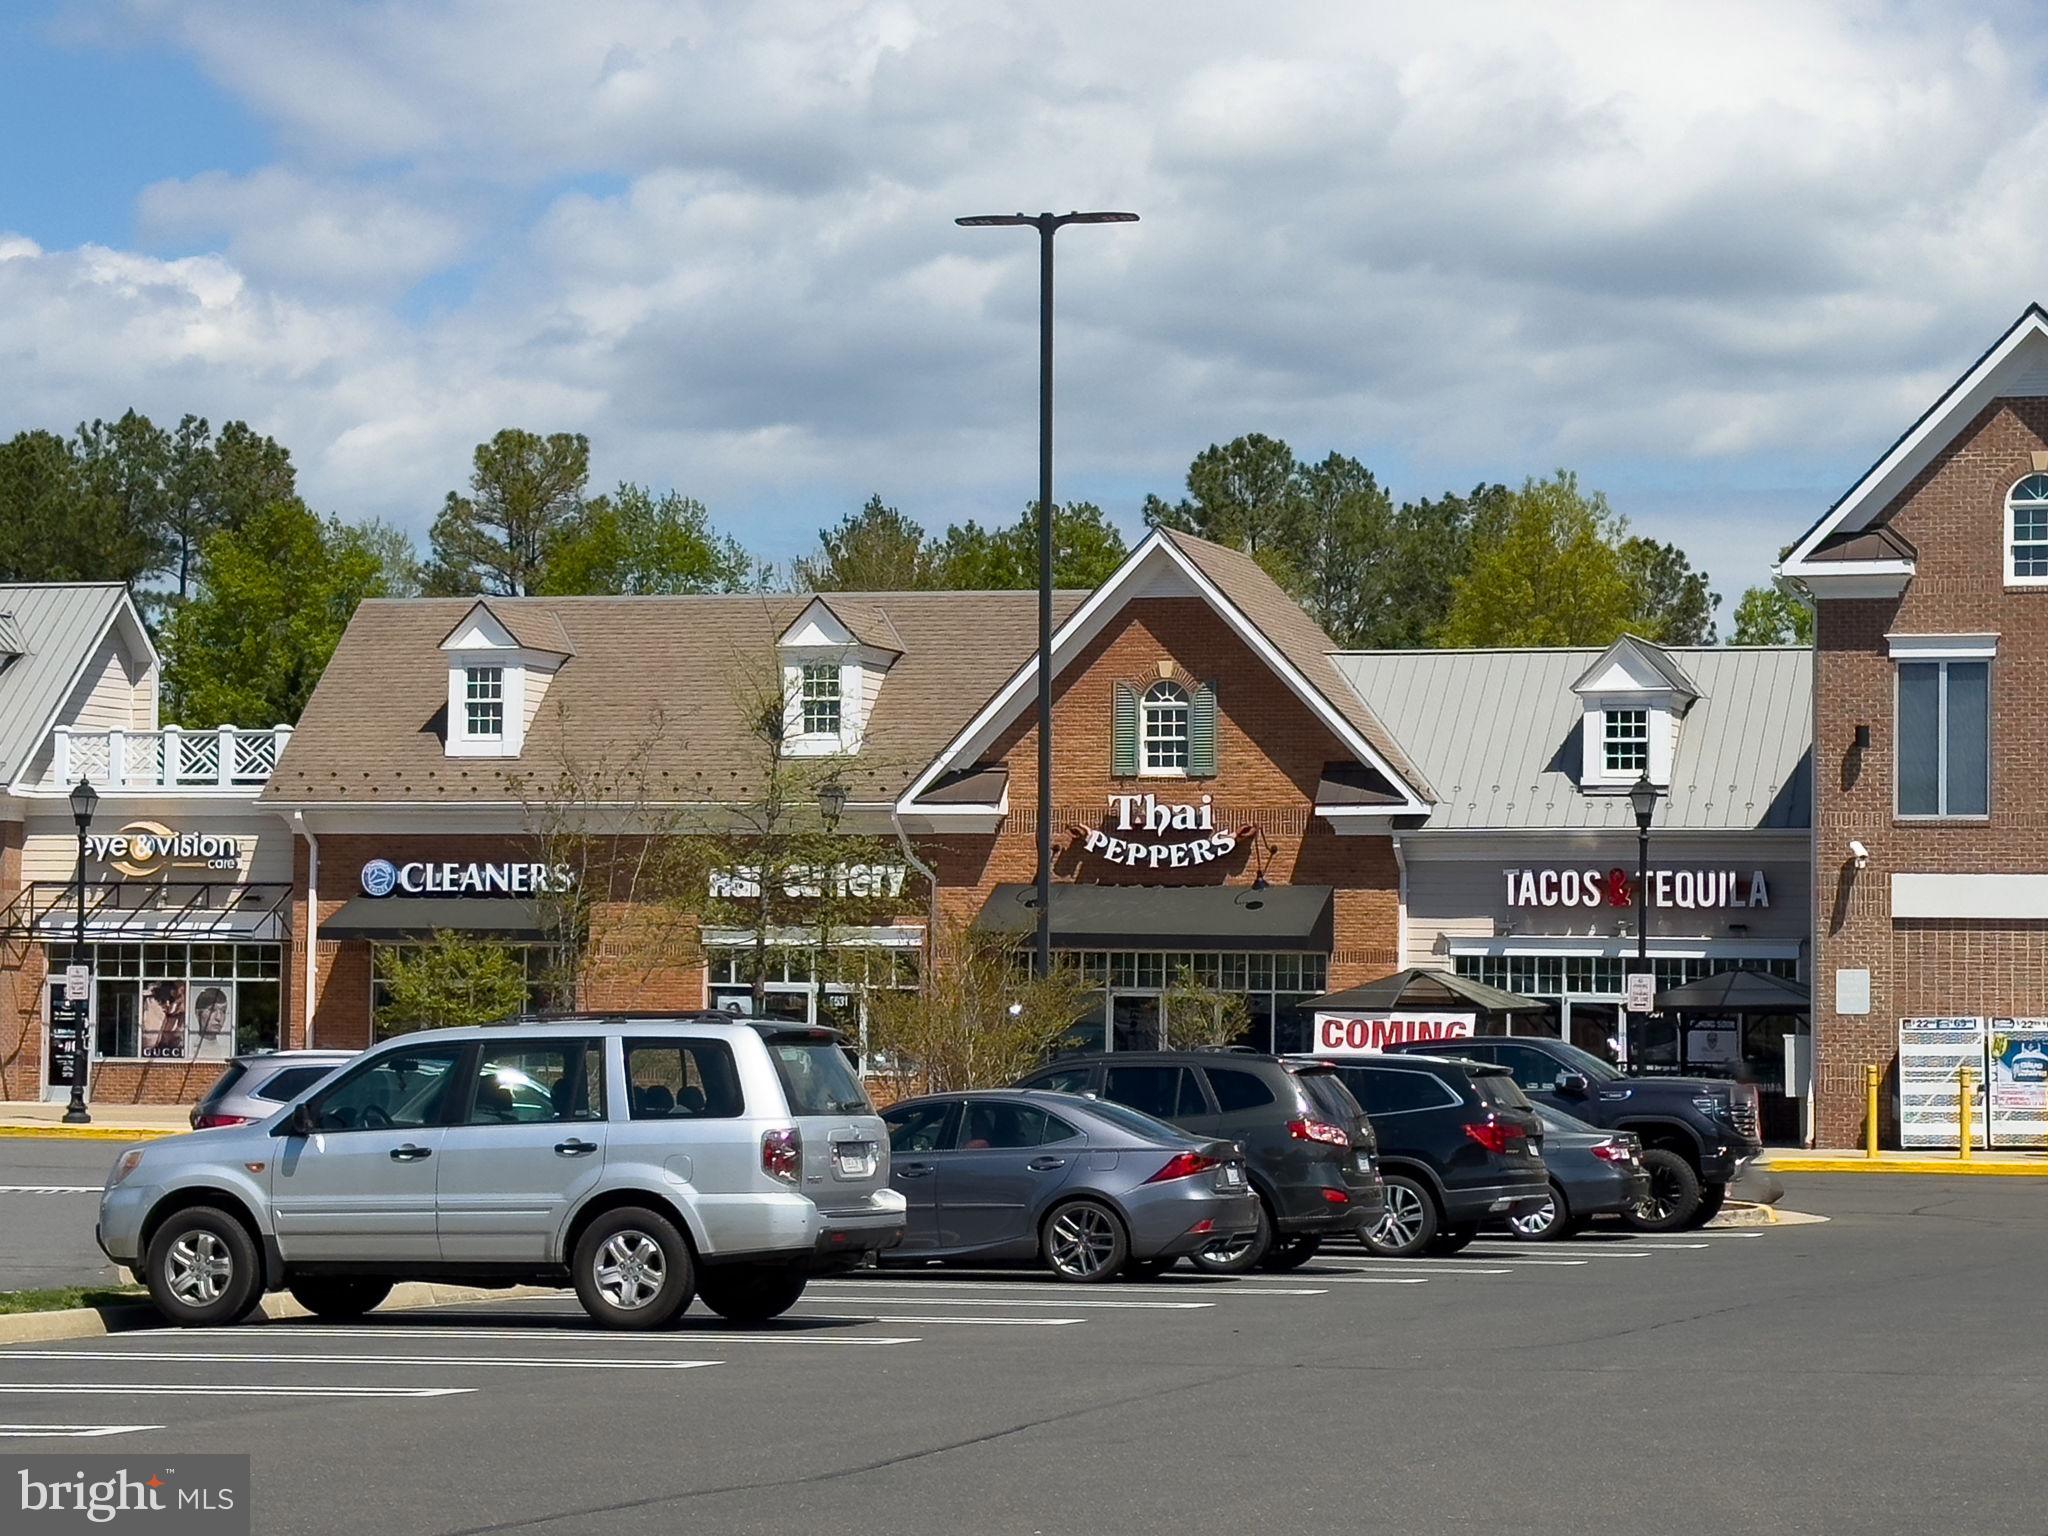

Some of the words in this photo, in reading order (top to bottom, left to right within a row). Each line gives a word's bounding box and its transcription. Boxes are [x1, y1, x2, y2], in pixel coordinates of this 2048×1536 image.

[1108, 794, 1213, 837] Thai
[136, 834, 154, 857] &
[155, 832, 235, 857] vision
[1084, 828, 1236, 868] PEPPERS
[207, 858, 235, 869] care
[401, 862, 570, 892] CLEANERS
[1503, 869, 1600, 907] TACOS
[1609, 868, 1631, 907] &
[1635, 869, 1769, 908] TEQUILA
[1322, 1019, 1467, 1048] COMING
[143, 1047, 184, 1057] GUCCI
